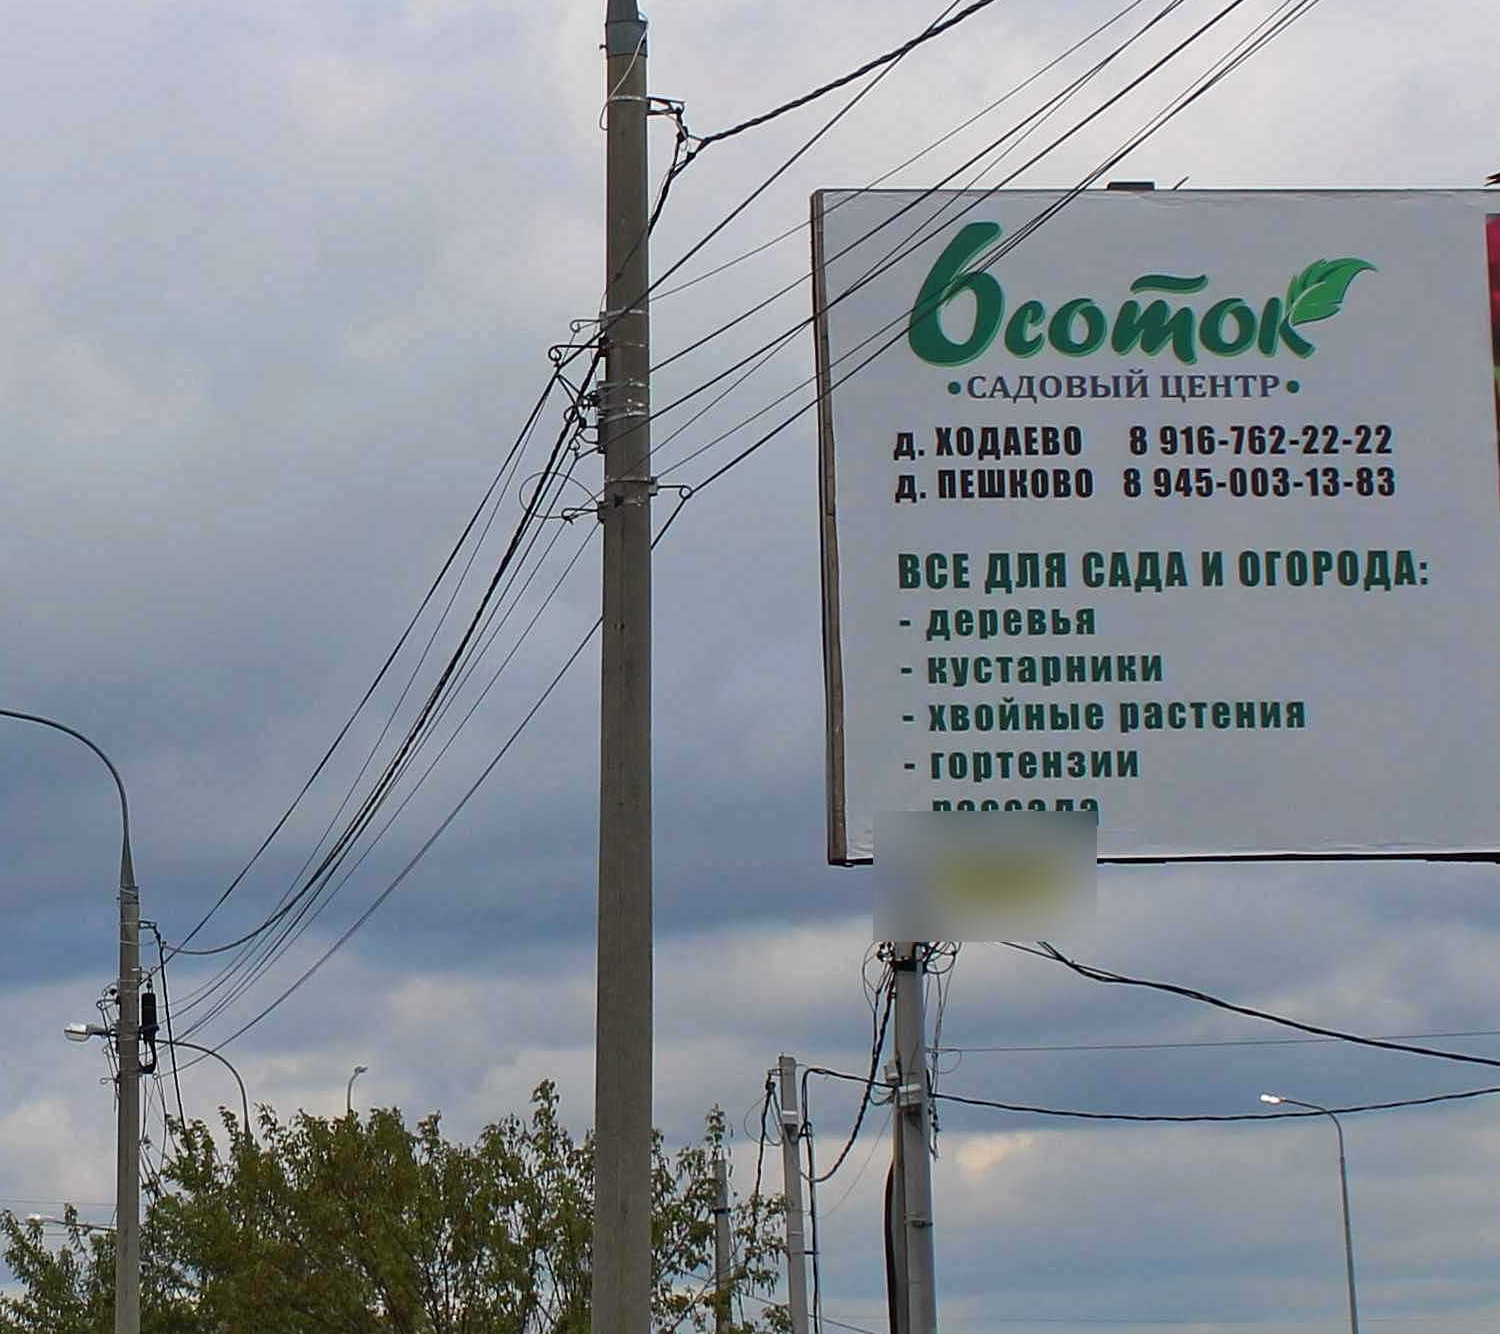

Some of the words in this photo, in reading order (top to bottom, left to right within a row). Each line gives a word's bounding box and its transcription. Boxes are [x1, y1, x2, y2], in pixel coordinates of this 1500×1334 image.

[966, 369, 1150, 403] САДОВЫЙ
[1159, 374, 1281, 403] ЦЕНТР
[893, 432, 925, 461] д.
[934, 425, 1082, 461] ХОДАЕВО
[1129, 425, 1148, 456] 8
[1159, 424, 1394, 456] 916-762-22-22
[894, 474, 927, 504] д.
[937, 468, 1094, 499] ПЕШКОВО
[1123, 467, 1142, 498] 8
[1153, 466, 1396, 498] 945-003-13-83
[898, 552, 971, 590] ВСЕ
[984, 552, 1067, 595] ДЛЯ
[1081, 551, 1189, 593] САДА
[1201, 551, 1224, 588] И
[1238, 549, 1430, 592] ОГОРОДА:
[925, 607, 1097, 642] деревья
[927, 654, 1164, 688] кустарники
[927, 696, 1105, 732] хвойные
[1119, 700, 1306, 734] растения
[930, 749, 1140, 784] гортензии
